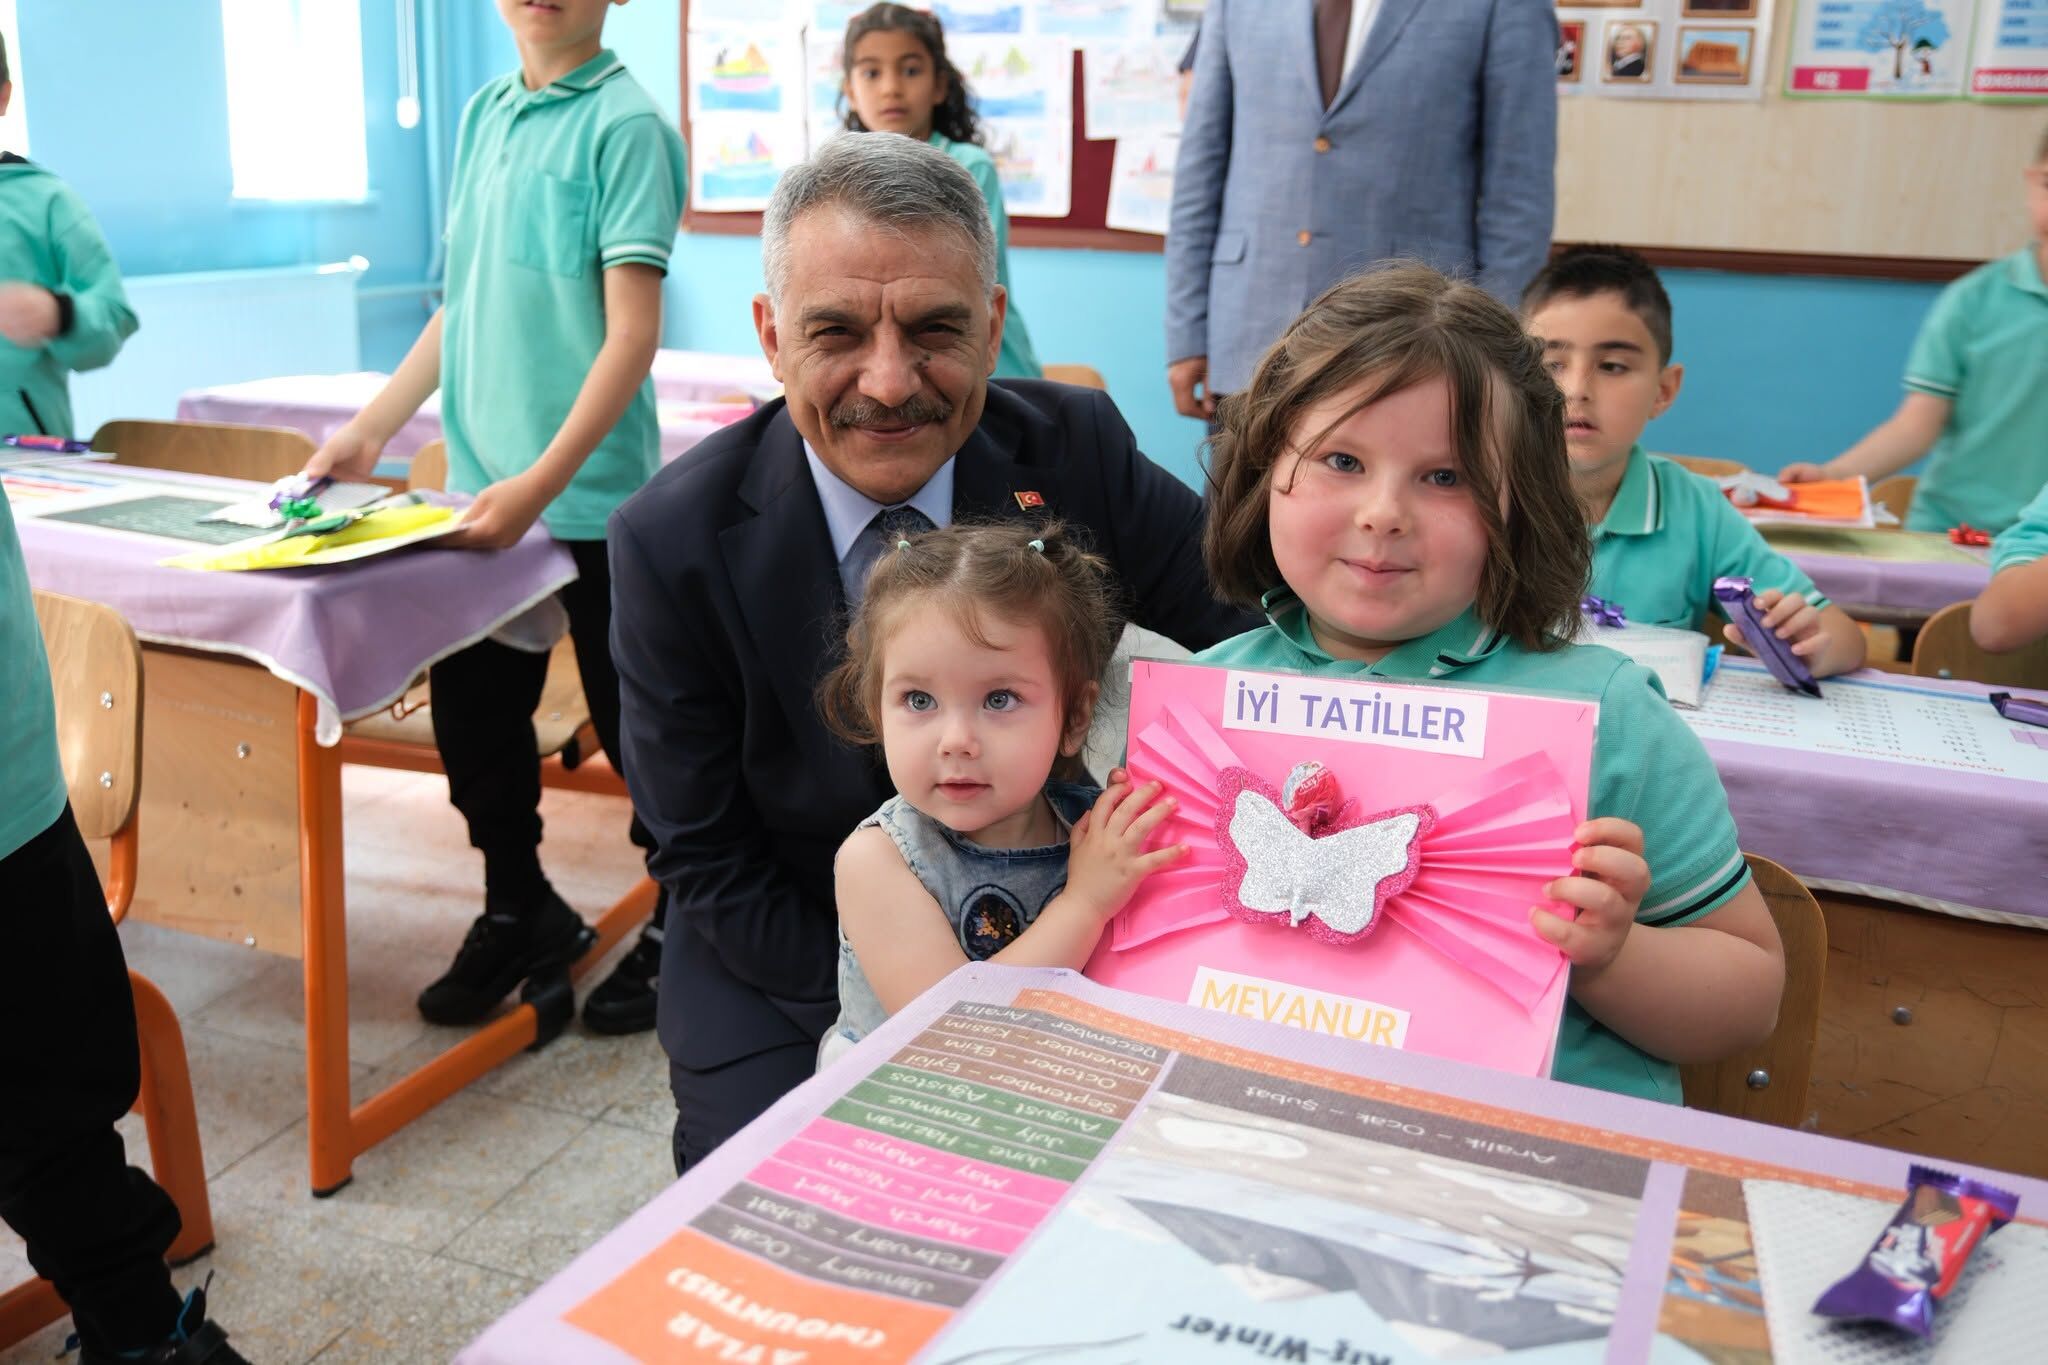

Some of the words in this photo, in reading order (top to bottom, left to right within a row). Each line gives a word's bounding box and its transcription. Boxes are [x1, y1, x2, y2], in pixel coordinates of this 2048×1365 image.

[1236, 680, 1279, 724] İYİ
[1299, 692, 1465, 743] TATİLLER
[944, 1018, 1011, 1039] Kasım
[959, 1002, 1028, 1023] Aralık
[1201, 979, 1397, 1046] MEVANUR
[944, 1038, 997, 1057] Ekim
[1049, 1020, 1157, 1059] December
[902, 1053, 961, 1073] Eylül
[1023, 1056, 1117, 1090] October
[1035, 1037, 1149, 1077] November
[888, 1070, 987, 1104] Ağustos
[988, 1073, 1117, 1114] September
[1245, 1084, 1321, 1113] Şubat
[887, 1094, 983, 1131] Temmuz
[1015, 1101, 1101, 1133] August
[1355, 1112, 1426, 1138] Ocak
[866, 1111, 959, 1148] Haziran
[1014, 1127, 1064, 1148] July
[853, 1136, 926, 1167] Mayıs
[989, 1145, 1049, 1171] June
[1464, 1136, 1557, 1166] Aralık
[825, 1157, 893, 1189] Nisan
[953, 1163, 1009, 1190] May
[792, 1175, 857, 1207] Mart
[921, 1187, 993, 1214] April
[889, 1206, 979, 1239] March
[727, 1224, 791, 1260] Ocak
[844, 1226, 974, 1271] February
[815, 1253, 934, 1296] January
[665, 1267, 887, 1348] (MOUNTHS)
[665, 1311, 808, 1365] AYLAR
